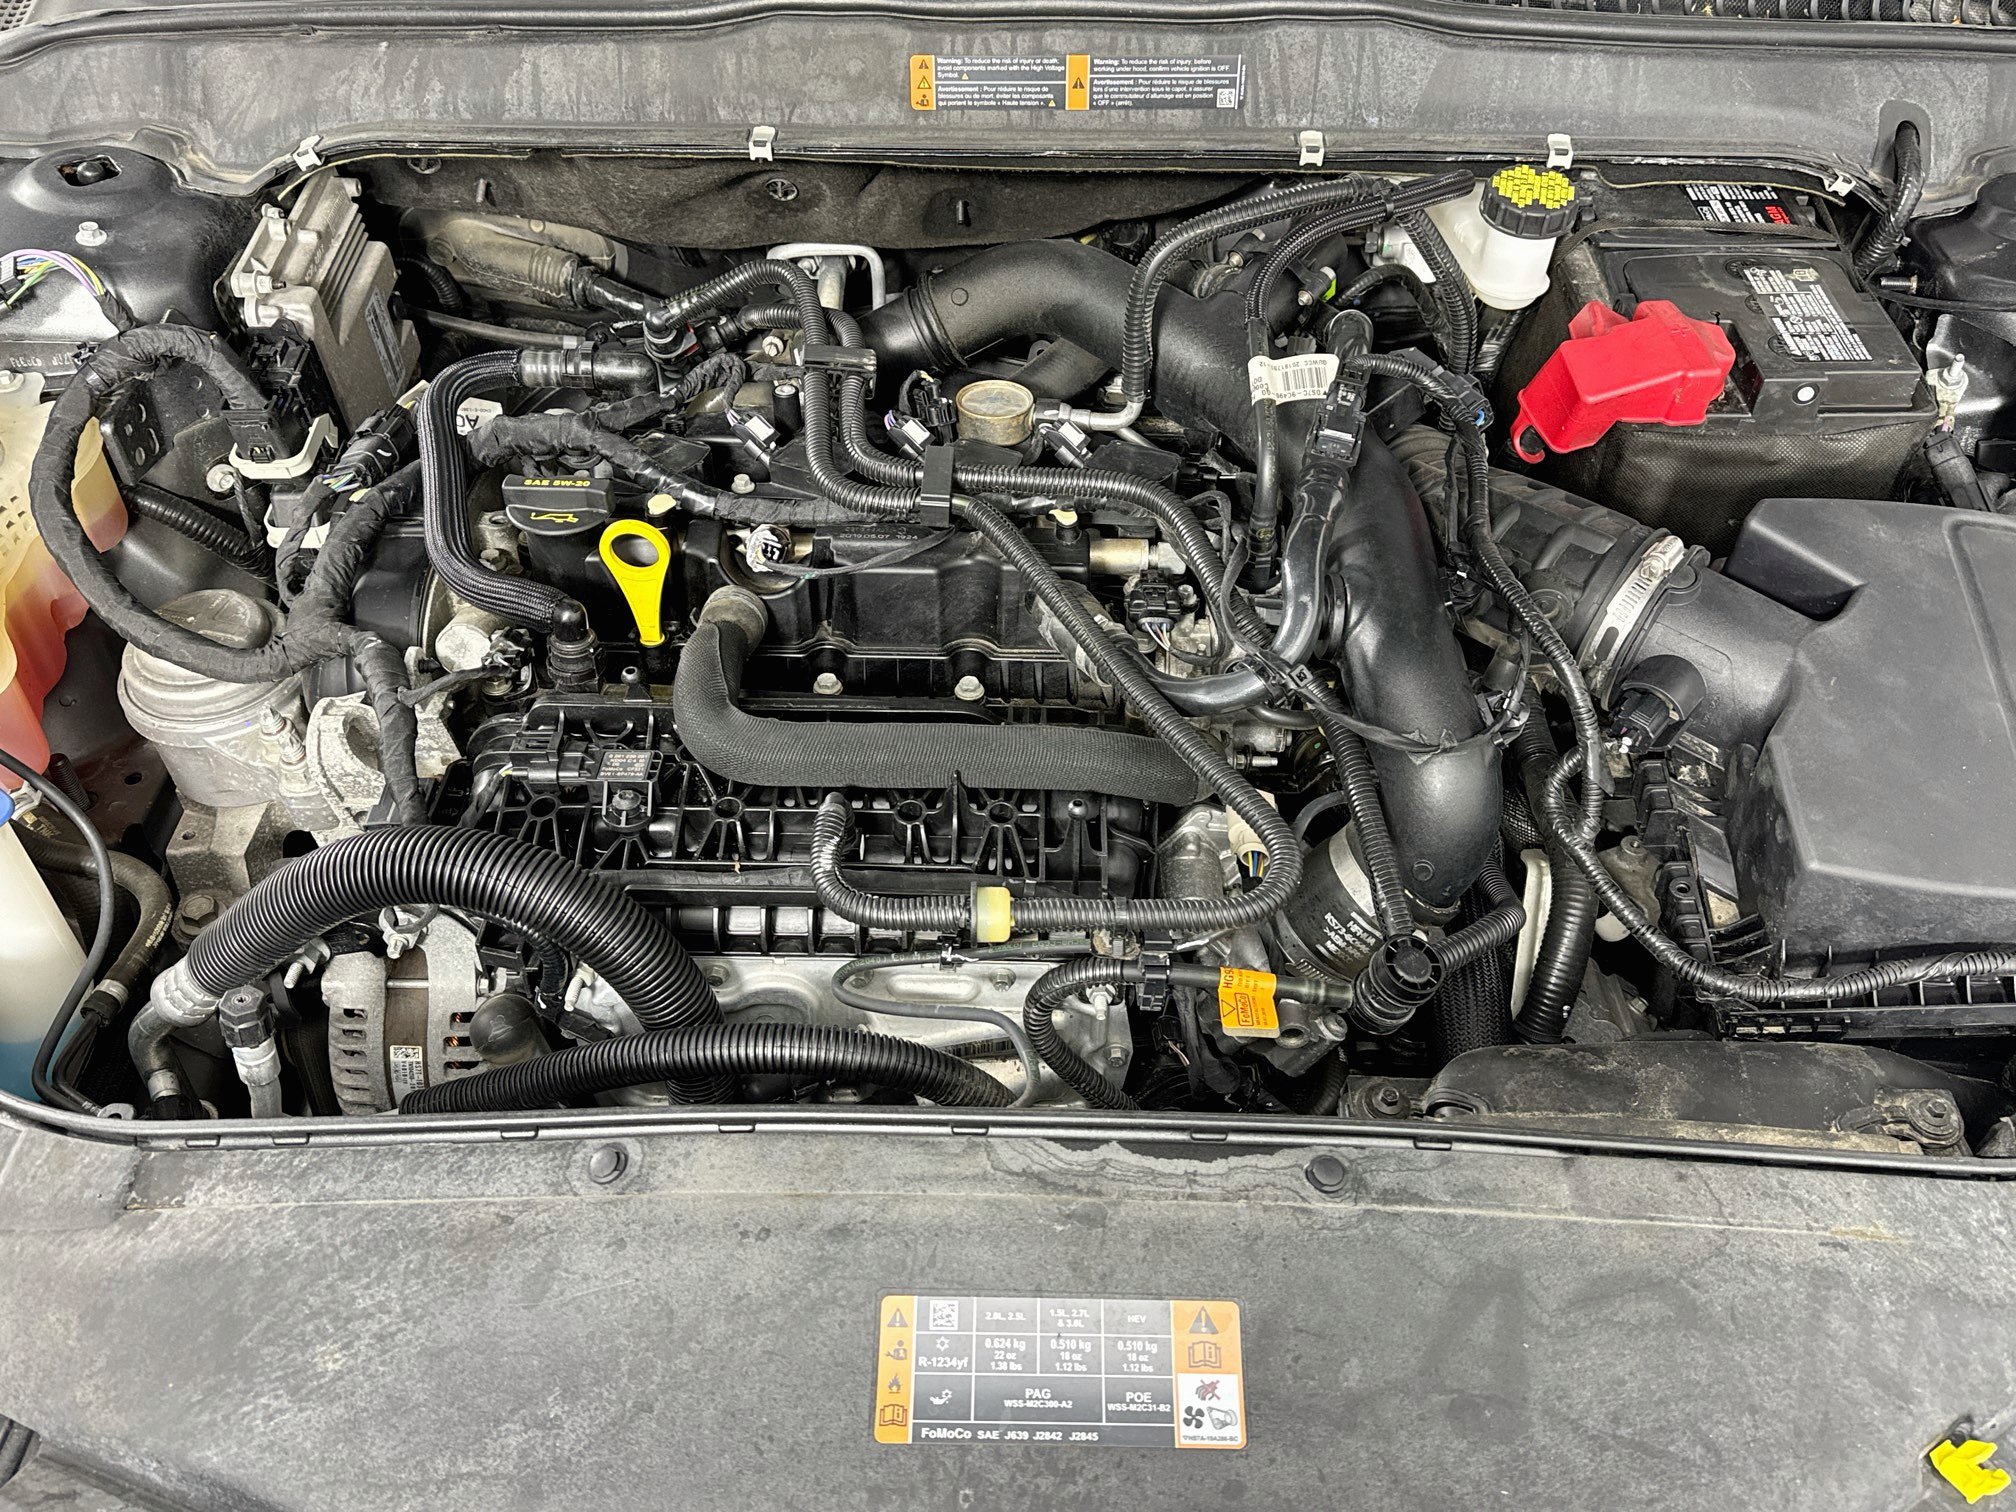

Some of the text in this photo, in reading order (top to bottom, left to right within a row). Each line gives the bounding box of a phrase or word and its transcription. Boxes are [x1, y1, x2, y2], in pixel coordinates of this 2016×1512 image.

[1240, 996, 1250, 1023] FoMoCo
[1128, 1315, 1146, 1323] HEV
[984, 1338, 1026, 1351] 0.624 kg
[1079, 1340, 1091, 1352] kg
[1145, 1341, 1158, 1353] kg
[918, 1356, 968, 1369] R-1234yf
[1009, 1362, 1022, 1370] lbs
[1055, 1362, 1087, 1371] 1.12 lbs
[1122, 1364, 1153, 1372] 1.12 lbs
[1025, 1388, 1051, 1399] PAG
[1126, 1392, 1152, 1403] POE
[921, 1428, 1099, 1441] FoMoCo SAE J639 J2842 J2845
